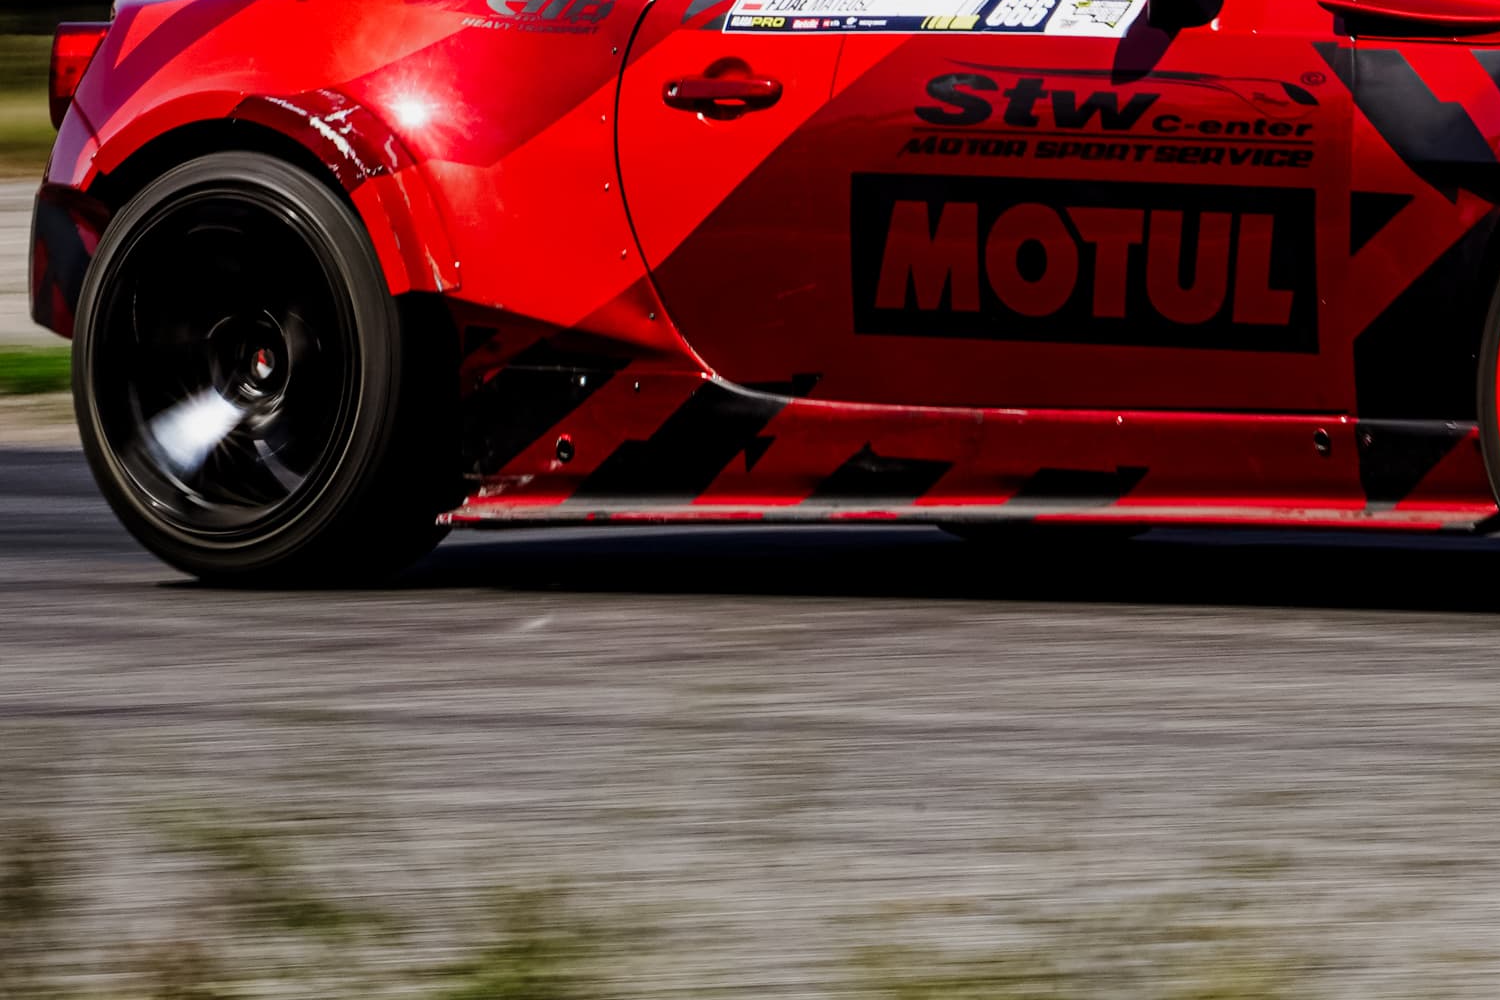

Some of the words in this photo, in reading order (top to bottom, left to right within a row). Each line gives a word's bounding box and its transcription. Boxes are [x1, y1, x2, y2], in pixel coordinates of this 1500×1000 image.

[461, 17, 513, 31] HEAVY
[1152, 113, 1313, 138] C-enter
[896, 134, 1027, 159] MOTOR
[874, 199, 1295, 326] MOTUL
